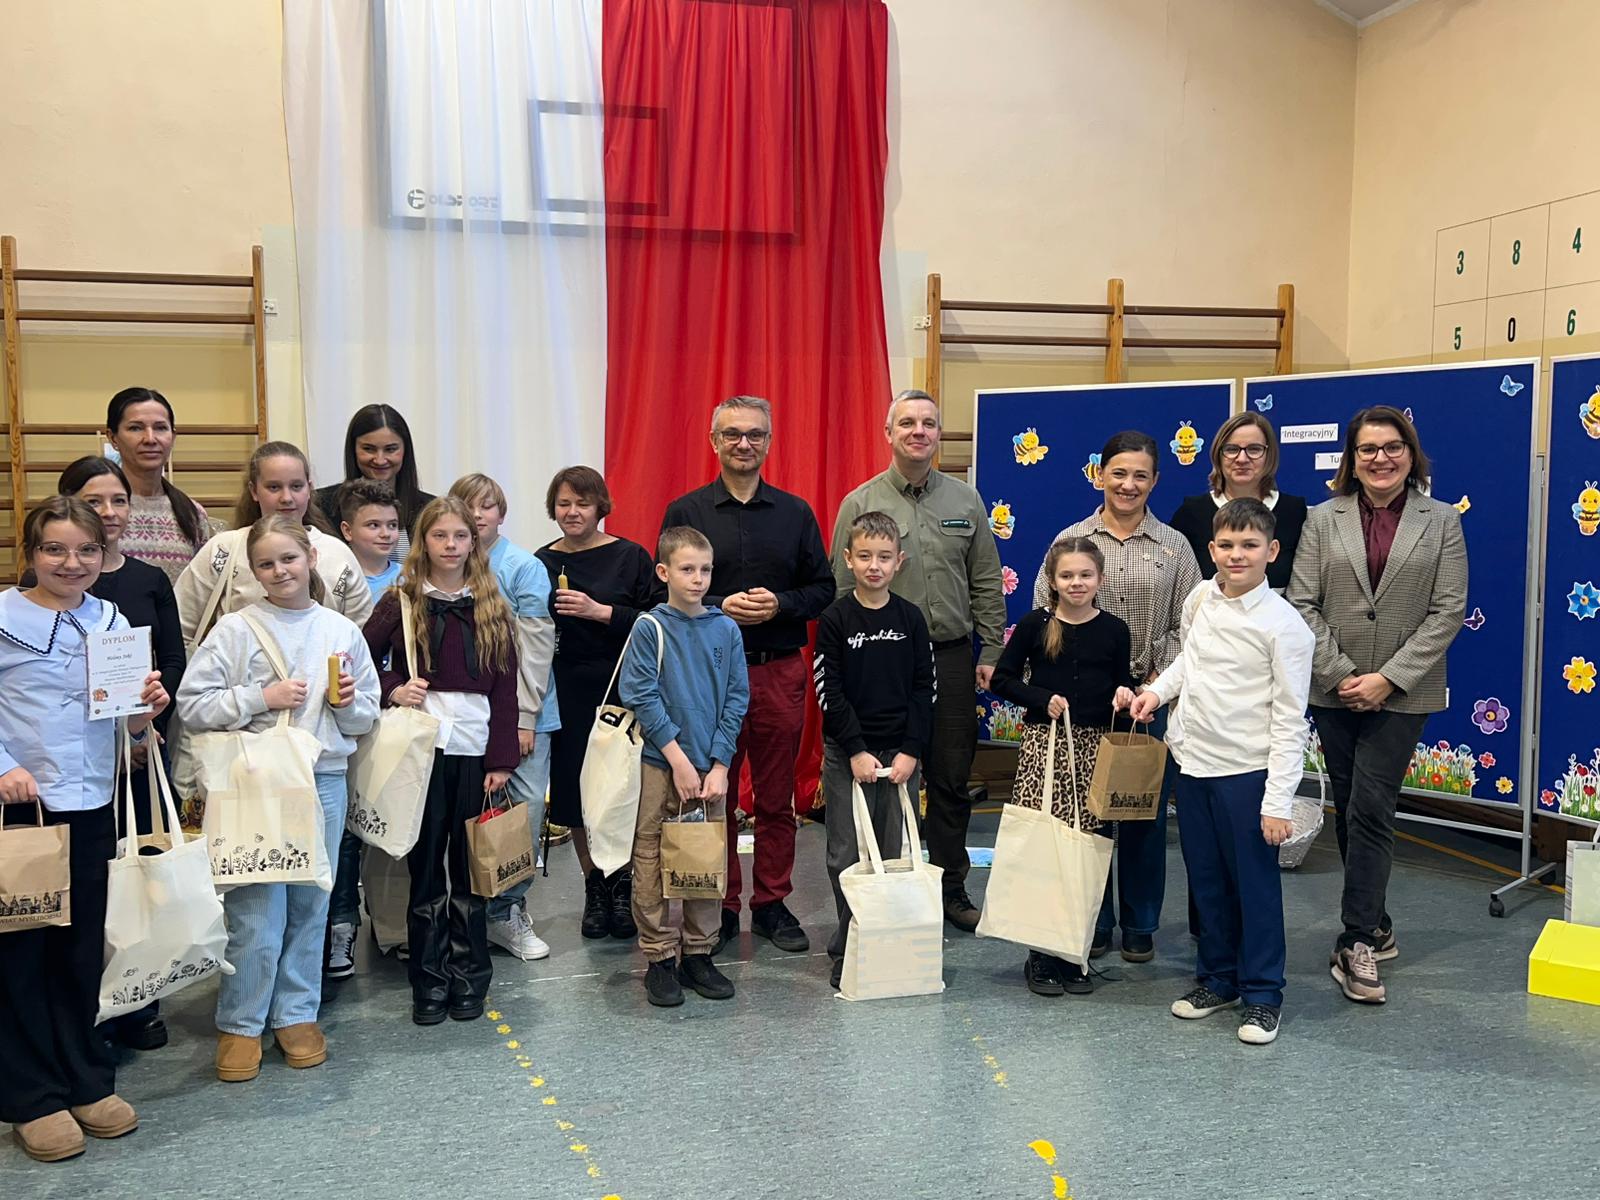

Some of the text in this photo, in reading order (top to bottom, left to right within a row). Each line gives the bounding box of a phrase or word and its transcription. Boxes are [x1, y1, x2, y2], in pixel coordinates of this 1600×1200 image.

[1456, 227, 1582, 275] 3 8 4
[1453, 309, 1577, 351] 5 0 6
[1284, 428, 1335, 440] Integracyjny
[102, 634, 136, 645] DYPLOM
